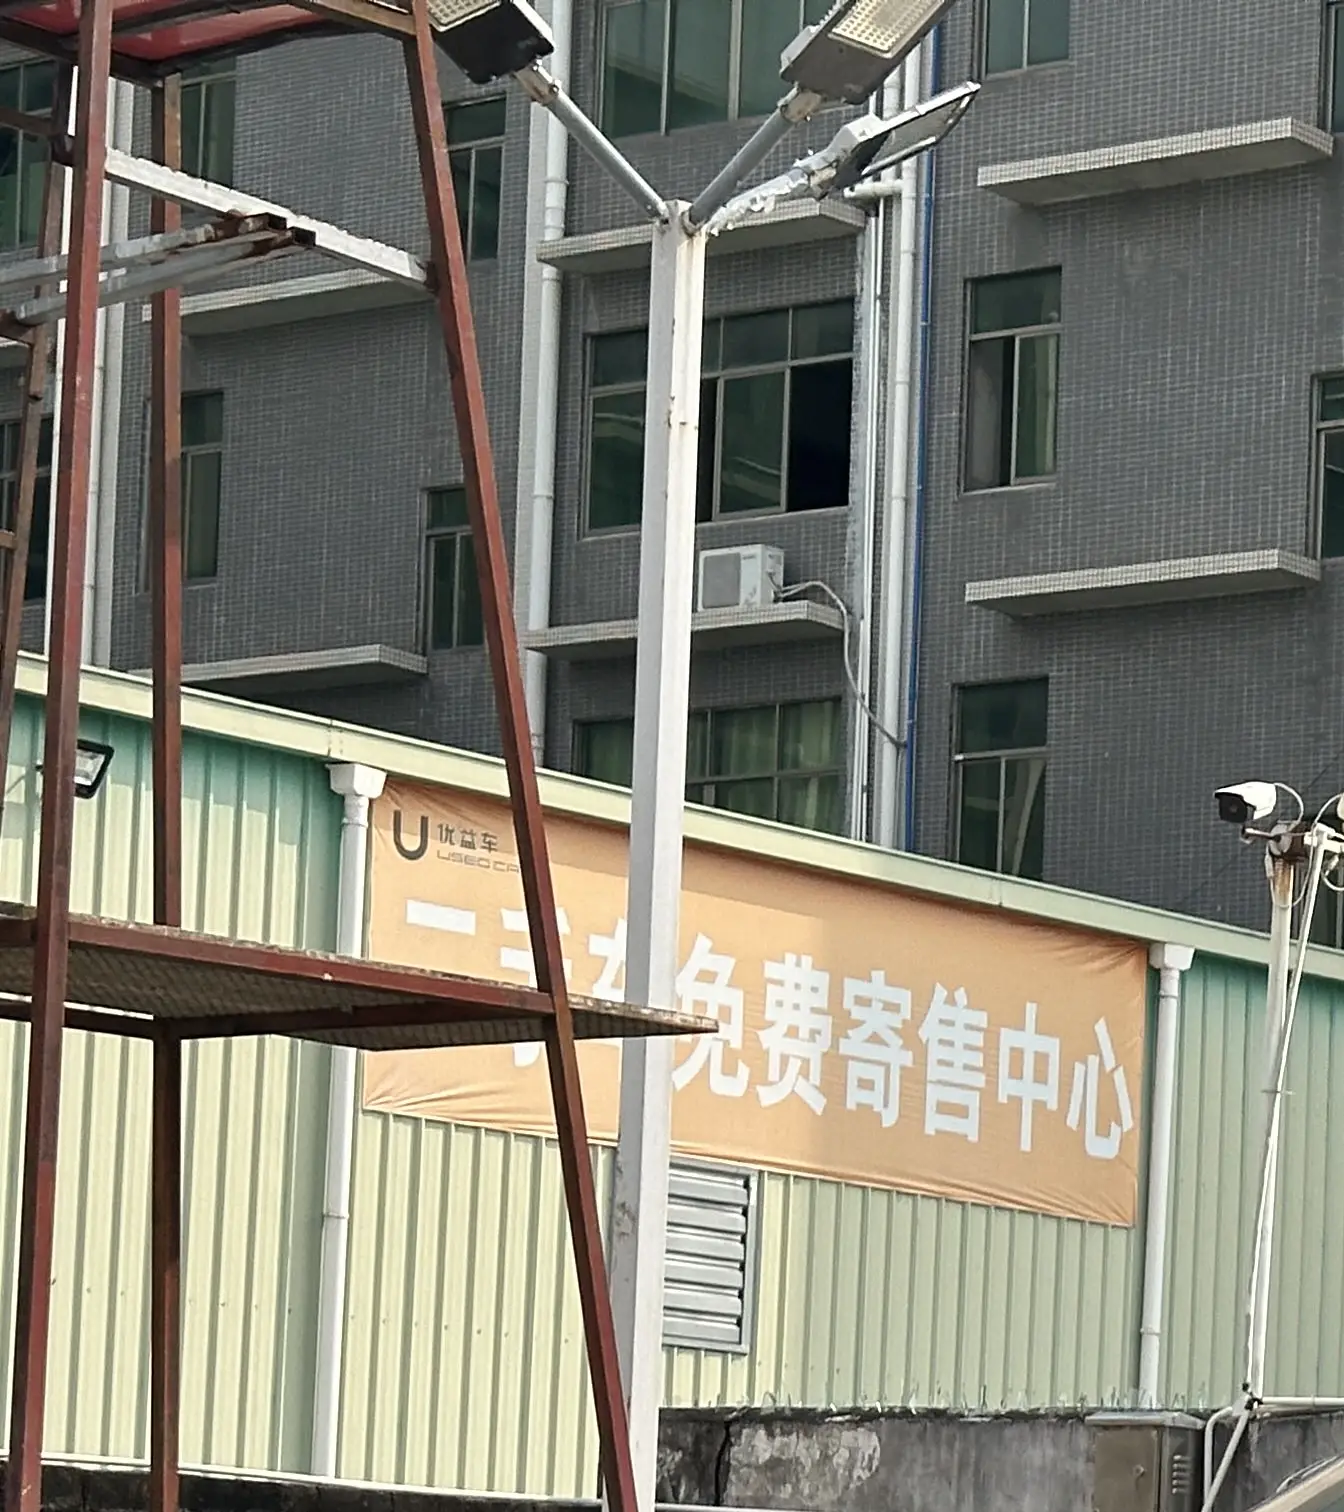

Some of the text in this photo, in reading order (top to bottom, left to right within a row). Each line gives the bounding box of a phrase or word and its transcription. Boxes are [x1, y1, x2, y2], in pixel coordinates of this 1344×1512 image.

[393, 810, 429, 861] U
[437, 823, 498, 853] 优益车
[437, 850, 520, 873] USED CA
